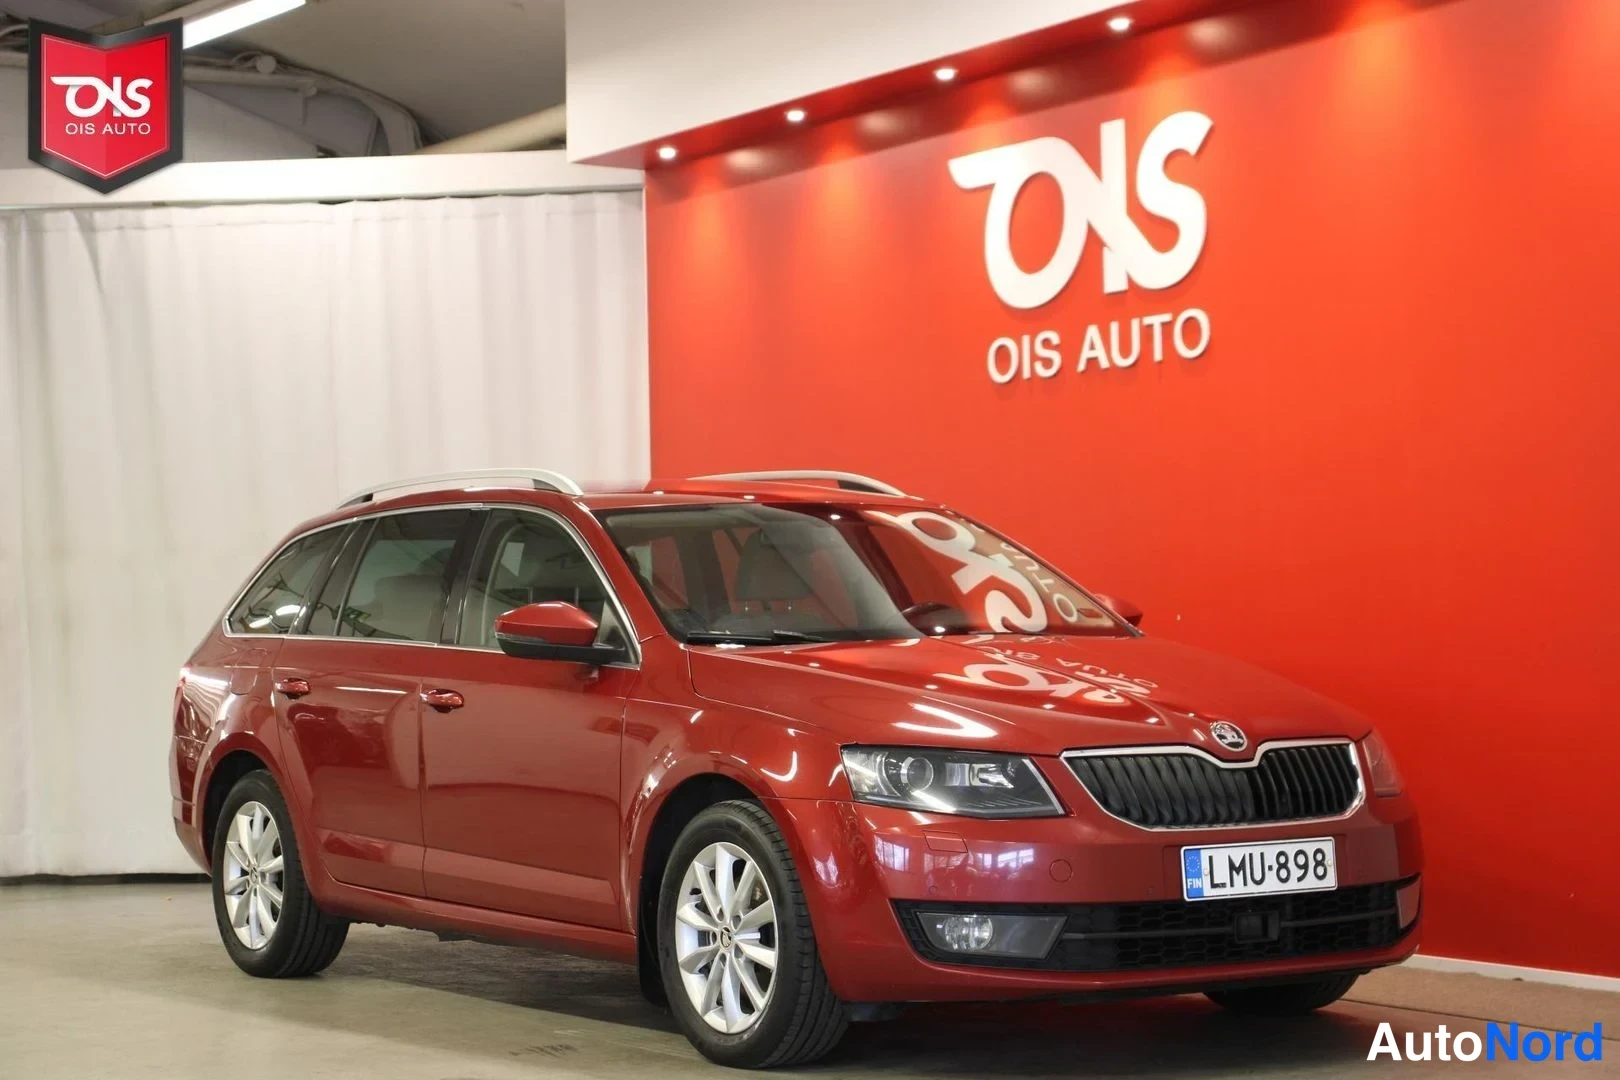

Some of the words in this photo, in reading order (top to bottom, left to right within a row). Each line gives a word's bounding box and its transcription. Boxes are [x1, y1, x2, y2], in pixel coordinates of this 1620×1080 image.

[986, 330, 1063, 385] OIS
[1076, 307, 1211, 373] AUTO
[1187, 877, 1203, 889] FIN
[1208, 848, 1328, 889] LMU-898
